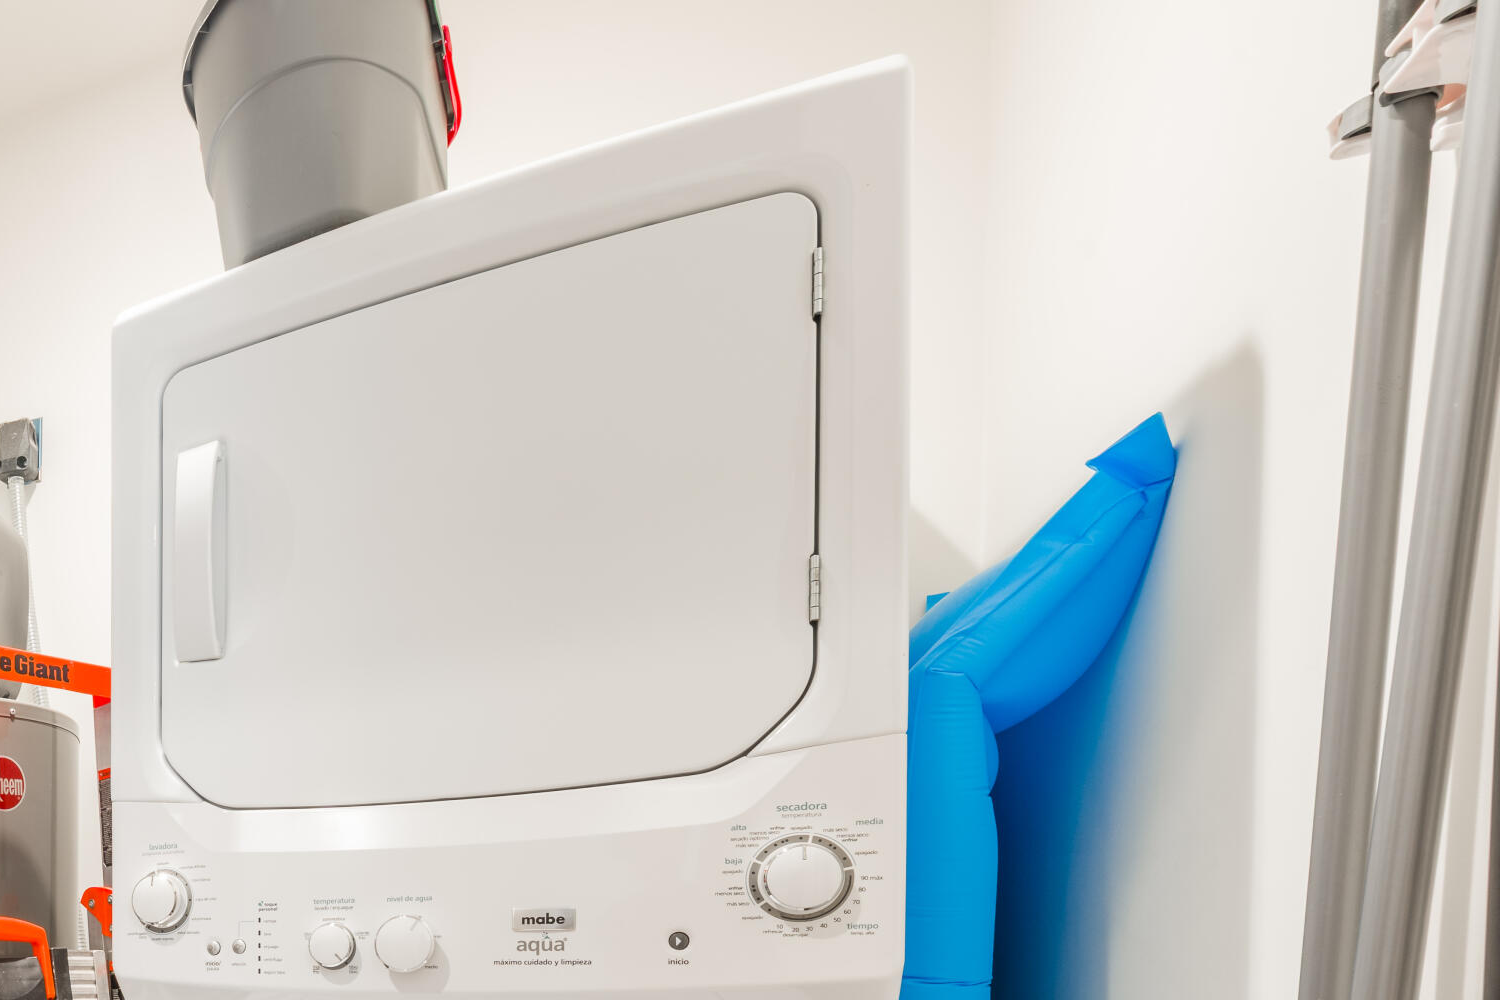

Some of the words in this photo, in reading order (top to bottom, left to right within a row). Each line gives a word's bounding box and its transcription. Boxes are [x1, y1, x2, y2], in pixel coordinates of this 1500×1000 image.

[14, 654, 70, 683] Giant
[776, 802, 828, 812] secadora
[855, 817, 884, 825] media
[521, 912, 566, 925] mabe
